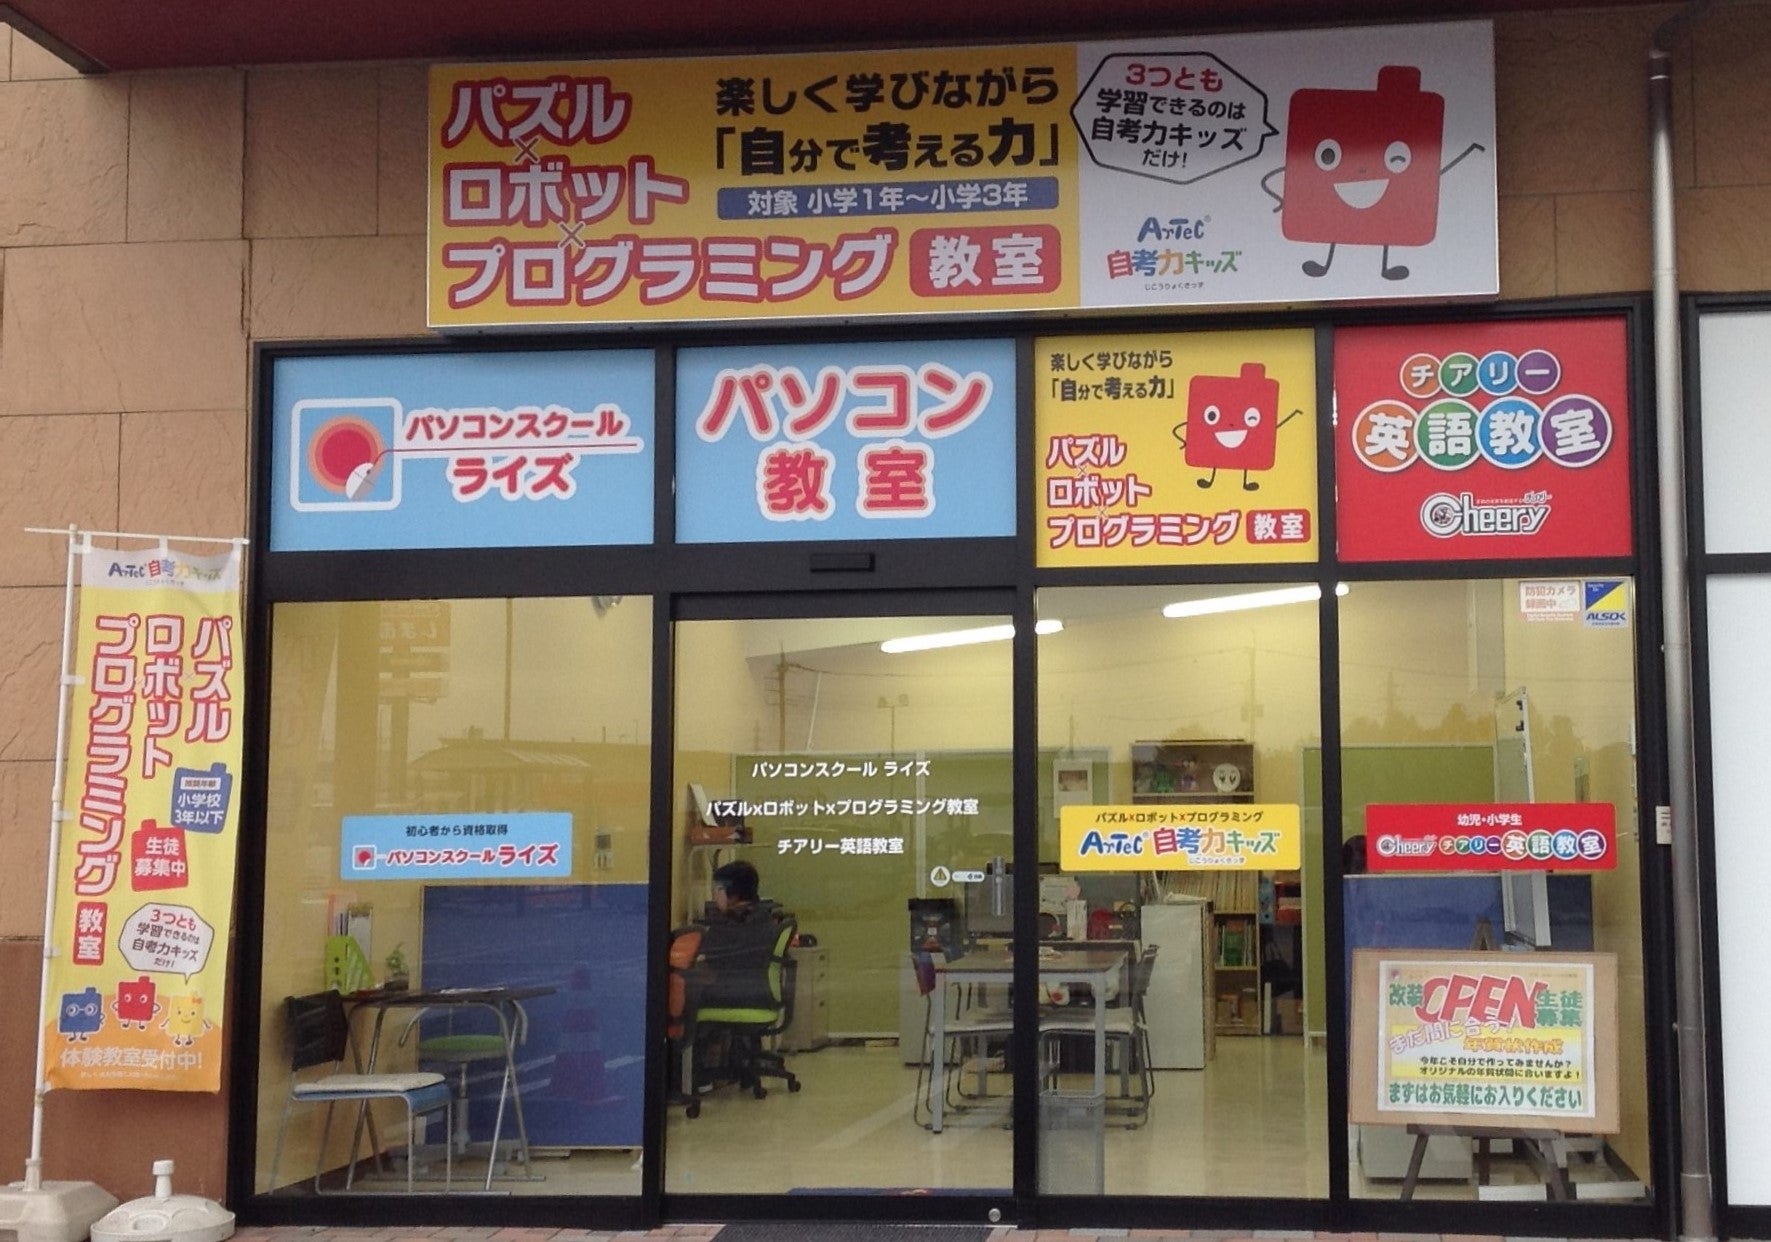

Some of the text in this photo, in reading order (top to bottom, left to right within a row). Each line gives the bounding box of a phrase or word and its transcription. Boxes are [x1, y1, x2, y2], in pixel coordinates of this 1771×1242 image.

[716, 66, 1060, 117] 楽しく学びながら
[1125, 63, 1223, 92] 3つとも
[443, 76, 632, 147] パズル
[1097, 88, 1246, 121] 学習できるのは
[715, 117, 1060, 176] 「自分で考える力」
[1091, 117, 1248, 151] 自考力キッズ
[444, 158, 690, 226] ロボット
[748, 189, 799, 217] 対象
[443, 227, 1045, 308] プログラミング 教室
[1107, 248, 1243, 279] 自考力キッズ
[1050, 350, 1174, 371] 楽しく学びながら
[1408, 359, 1552, 389] チアリー
[701, 367, 990, 437] パソコン
[1051, 375, 1176, 402] 「自分で考える力」
[404, 409, 626, 443] パソコンスクール
[1364, 408, 1602, 461] 英語教室
[1047, 434, 1126, 469] パズル
[449, 452, 576, 496] ライズ
[764, 445, 929, 514] 教室
[1047, 474, 1152, 507] ロボット
[1047, 510, 1305, 549] プログラミング 教室
[1421, 492, 1551, 538] Cheery
[1586, 612, 1626, 621] ALSOK
[185, 615, 232, 743] パズル
[141, 613, 185, 779] ロボット
[752, 760, 931, 778] パソコンスクール ライズ
[75, 613, 141, 960] プログラミング 教室
[177, 793, 221, 808] 小学校
[174, 809, 224, 825] 3年以下
[405, 824, 509, 838] 初心者から資格取得
[146, 836, 180, 856] 生徒
[386, 843, 560, 867] パソコンスクール ライズ
[777, 837, 904, 855] チアリー英語教室
[1152, 826, 1282, 856] 自考力キッズ
[1442, 837, 1503, 852] チアリー
[1505, 834, 1606, 857] 英語教室
[134, 858, 187, 879] 募集中
[150, 909, 196, 931] 3つとも
[132, 938, 199, 961] 自考力キッズ
[1388, 1082, 1582, 1109] まずはお気軽にお入りください
